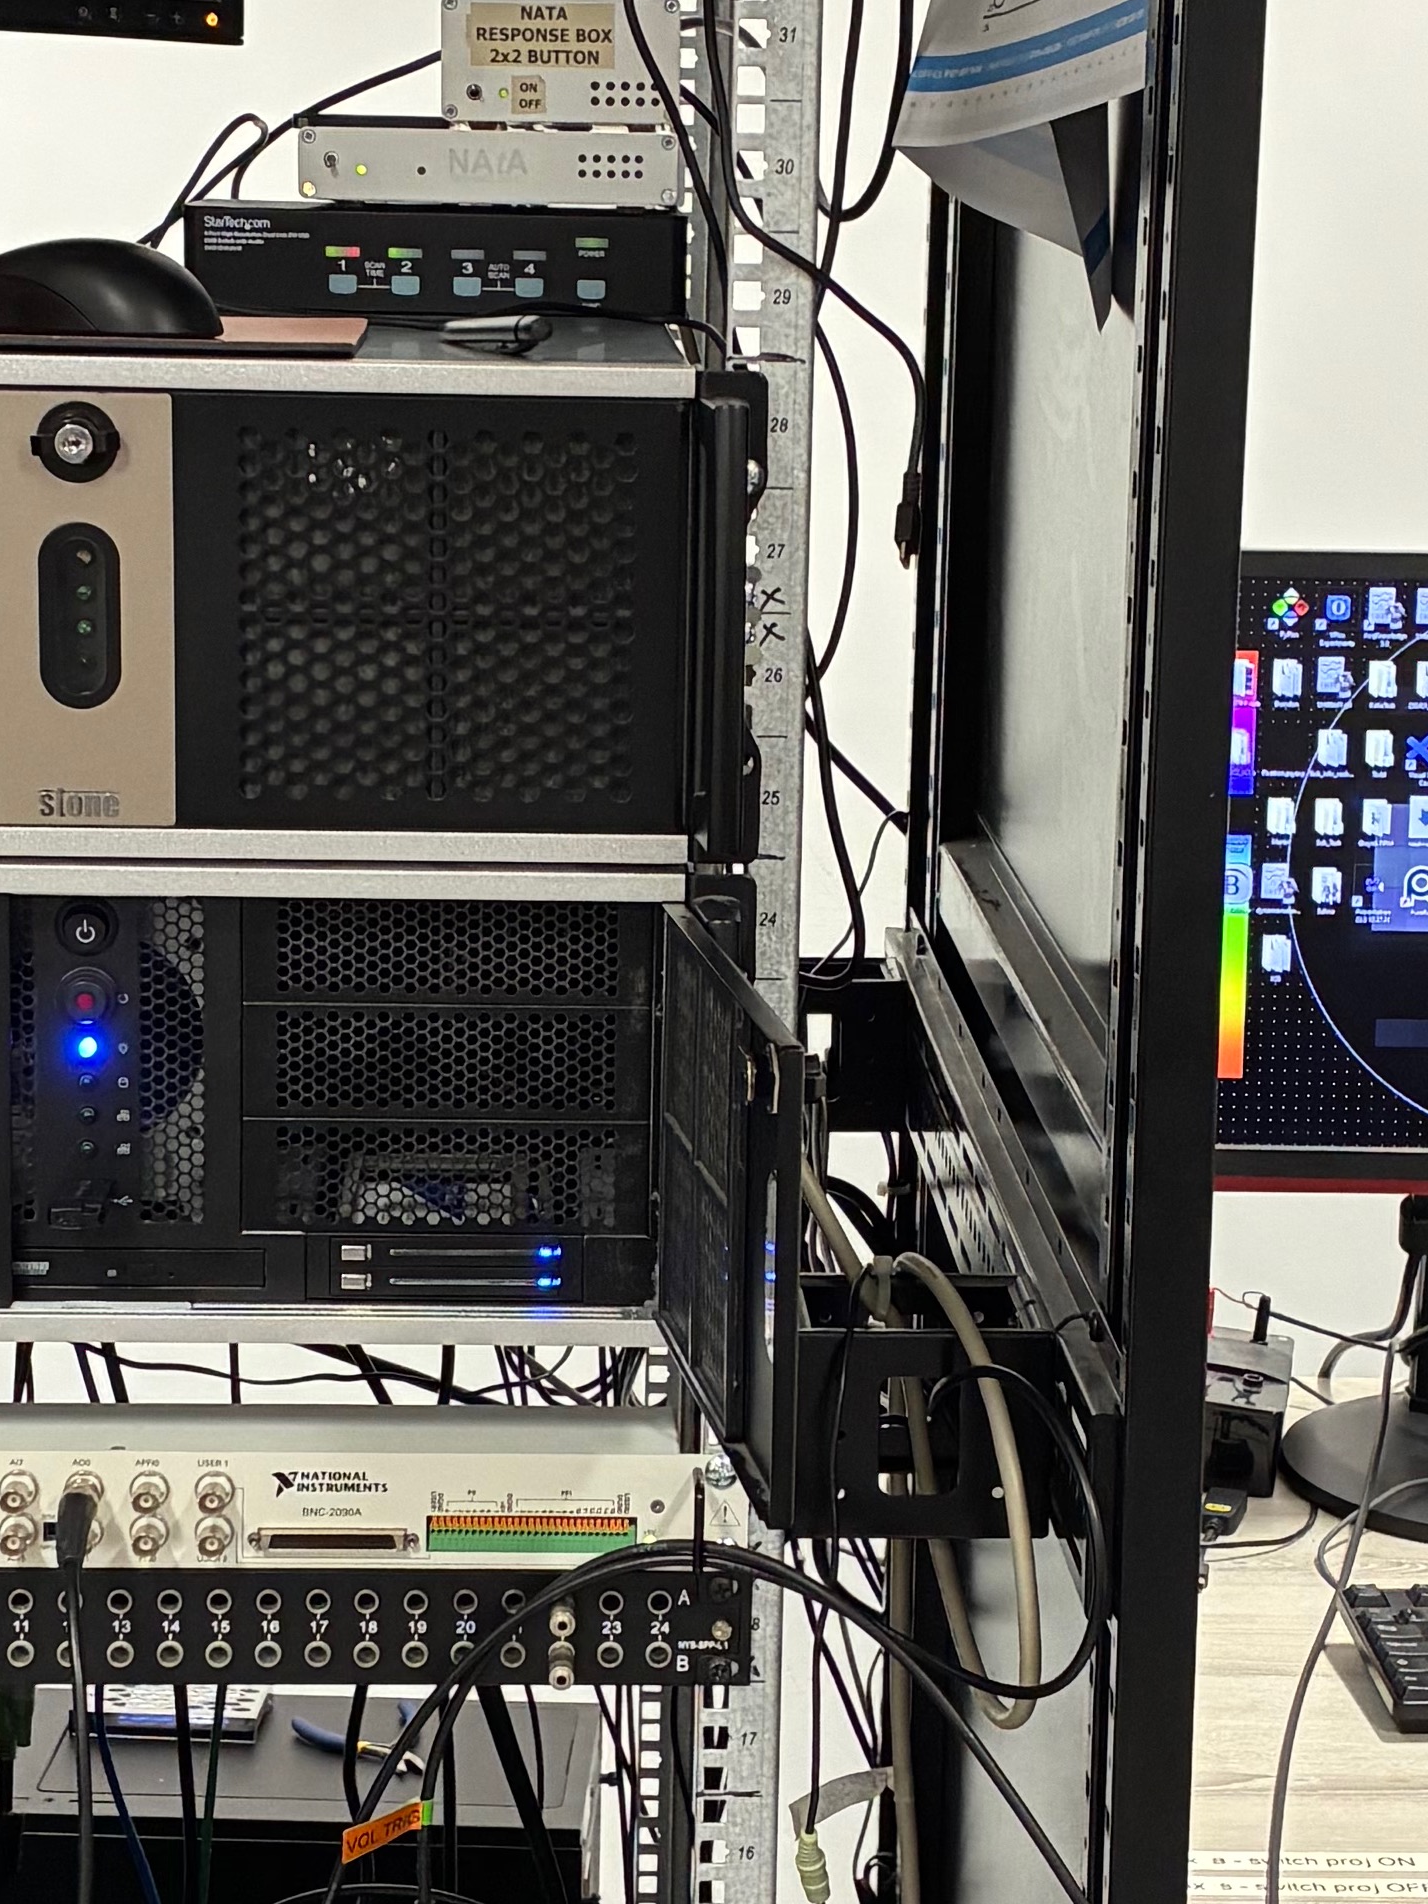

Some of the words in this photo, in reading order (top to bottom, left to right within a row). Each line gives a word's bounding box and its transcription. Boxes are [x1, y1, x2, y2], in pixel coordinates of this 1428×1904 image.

[520, 5, 568, 21] NATA
[475, 26, 570, 43] RESPONSE
[575, 28, 613, 44] BOX
[777, 27, 795, 43] 31
[489, 48, 522, 64] 2x2
[527, 49, 600, 65] BUTTON
[519, 82, 538, 93] ON
[518, 99, 542, 109] OFF
[774, 159, 793, 175] 30
[338, 261, 346, 272] 1
[400, 261, 413, 273] 2
[461, 262, 474, 274] 3
[488, 263, 510, 272] AUTO
[523, 263, 536, 274] 4
[771, 288, 790, 305] 29
[770, 417, 789, 433] 28
[766, 543, 786, 559] 27
[764, 667, 783, 683] 26
[38, 787, 120, 818] stone
[761, 789, 781, 806] 25
[758, 912, 778, 927] 24
[300, 1471, 369, 1481] NATIONAL
[296, 1482, 388, 1493] INSTRUMENTS
[677, 1589, 691, 1606] A
[12, 1620, 29, 1632] 11
[111, 1620, 131, 1633] 13
[161, 1620, 180, 1633] 14
[211, 1620, 230, 1633] 15
[261, 1621, 280, 1633] 16
[310, 1620, 329, 1633] 17
[359, 1621, 378, 1633] 18
[408, 1621, 427, 1633] 19
[455, 1621, 477, 1634] 20
[601, 1621, 622, 1634] 23
[649, 1621, 671, 1634] 24
[676, 1655, 690, 1672] B
[740, 1732, 756, 1746] 17
[346, 1829, 379, 1854] VOL
[383, 1809, 420, 1838] TRIG
[737, 1846, 754, 1860] 16
[1325, 1857, 1371, 1869] proj
[1378, 1857, 1417, 1867] ON
[1333, 1882, 1380, 1895] proj
